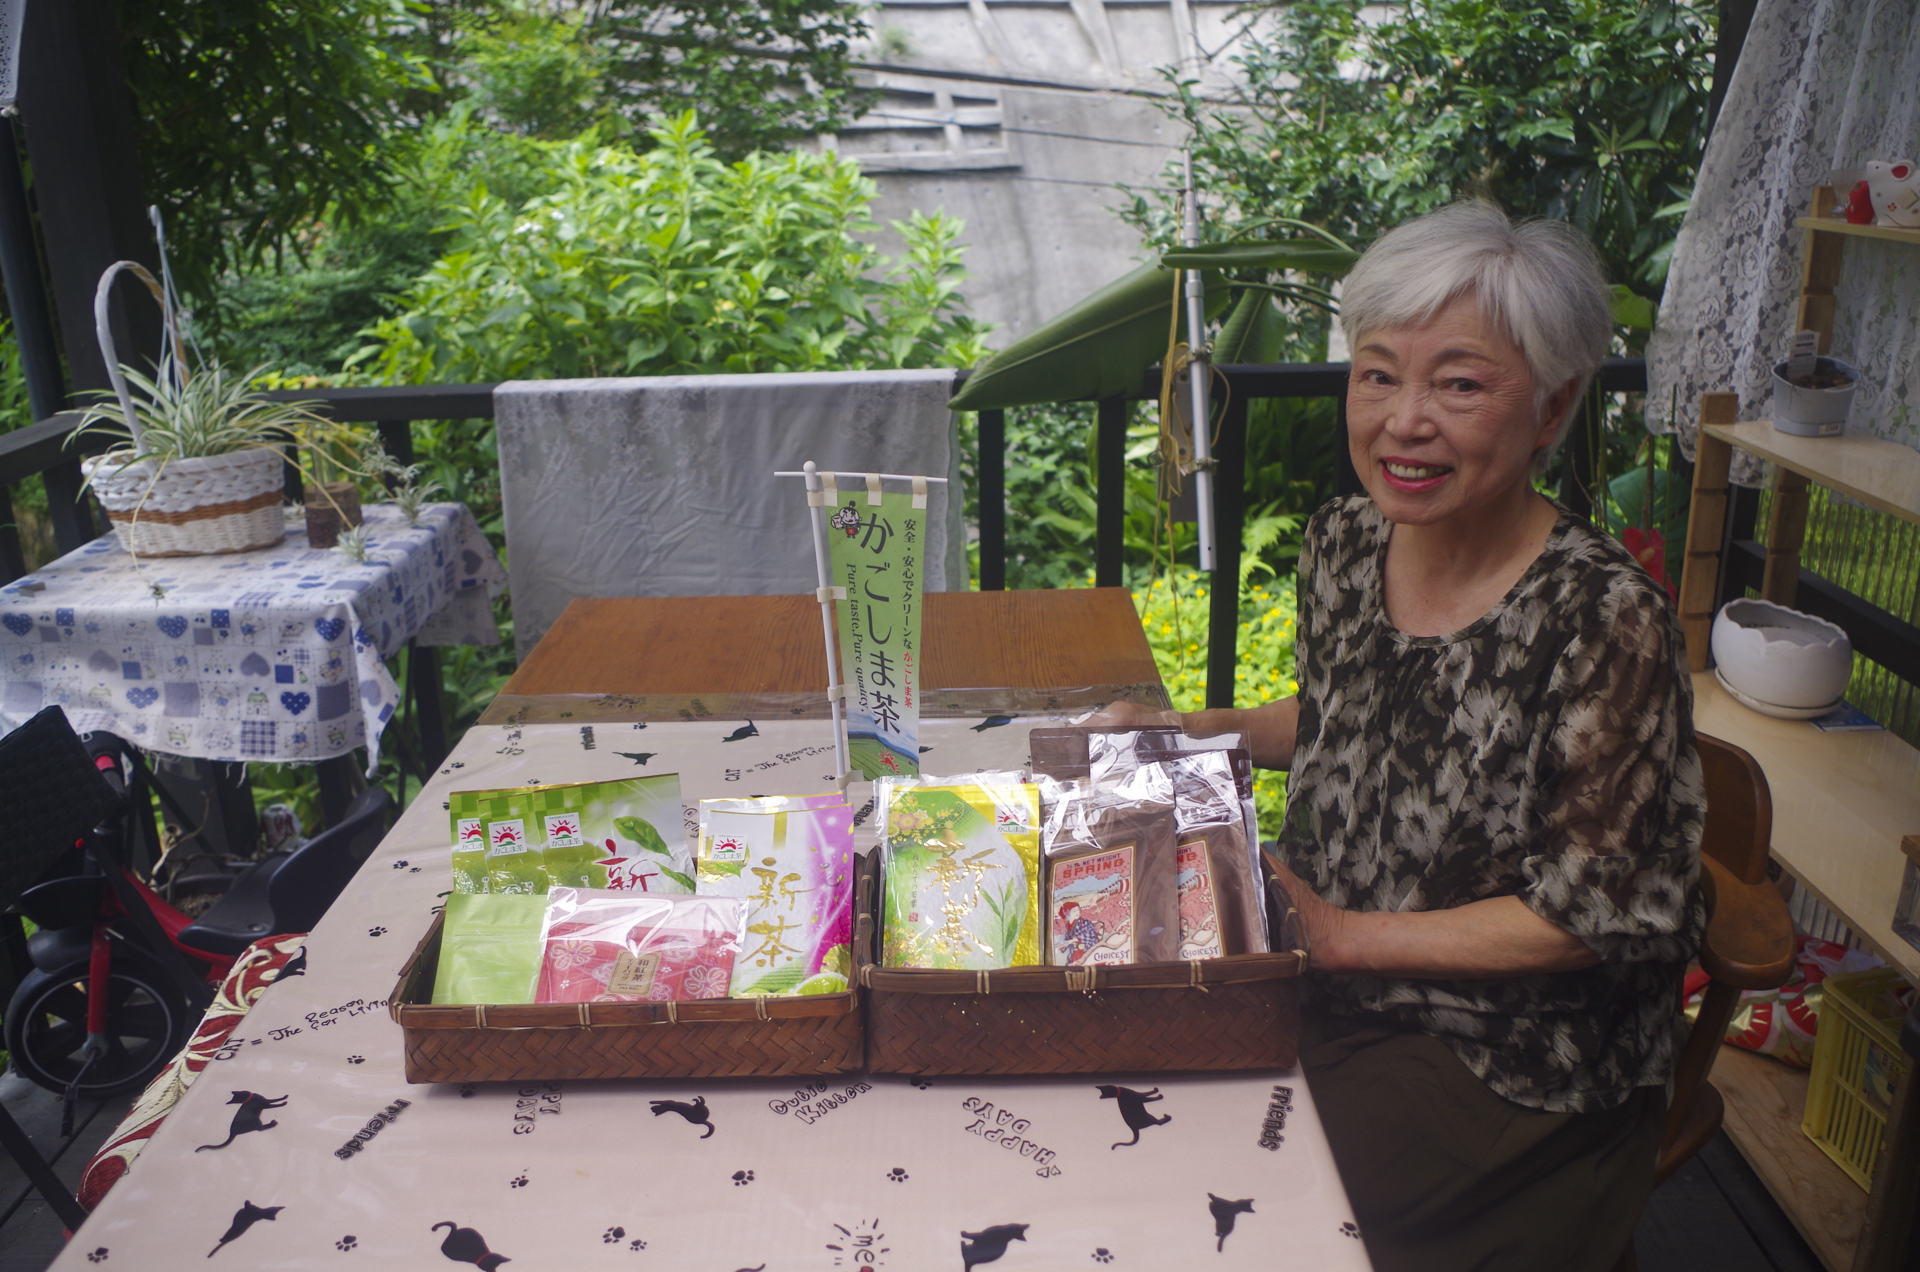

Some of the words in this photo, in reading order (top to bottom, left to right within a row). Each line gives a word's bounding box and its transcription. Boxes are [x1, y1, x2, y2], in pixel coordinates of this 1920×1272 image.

[846, 563, 857, 594] Pure
[855, 667, 869, 712] quality.
[860, 512, 901, 735] かごしま茶
[725, 768, 741, 781] CAT
[775, 746, 814, 760] Reason
[1062, 858, 1125, 879] SPRING
[1096, 853, 1122, 863] WEIGHT
[739, 857, 816, 968] 新茶
[923, 829, 1009, 964] 新茶
[632, 959, 650, 981] 和紅茶
[1093, 949, 1131, 961] CHOICEST
[1181, 945, 1219, 958] CHOICEST
[215, 1037, 246, 1061] CAT
[267, 1026, 303, 1041] The
[305, 998, 364, 1023] Reason
[310, 1017, 338, 1031] for
[349, 999, 388, 1017] Livin
[513, 1087, 540, 1135] DAYS
[768, 1080, 828, 1115] Cutie
[794, 1082, 873, 1125] Kitten
[962, 1096, 1032, 1135] DAYS
[333, 1099, 412, 1161] Friends
[1257, 1085, 1294, 1152] Friends
[964, 1118, 1057, 1166] HAPPY
[851, 1234, 876, 1264] me
